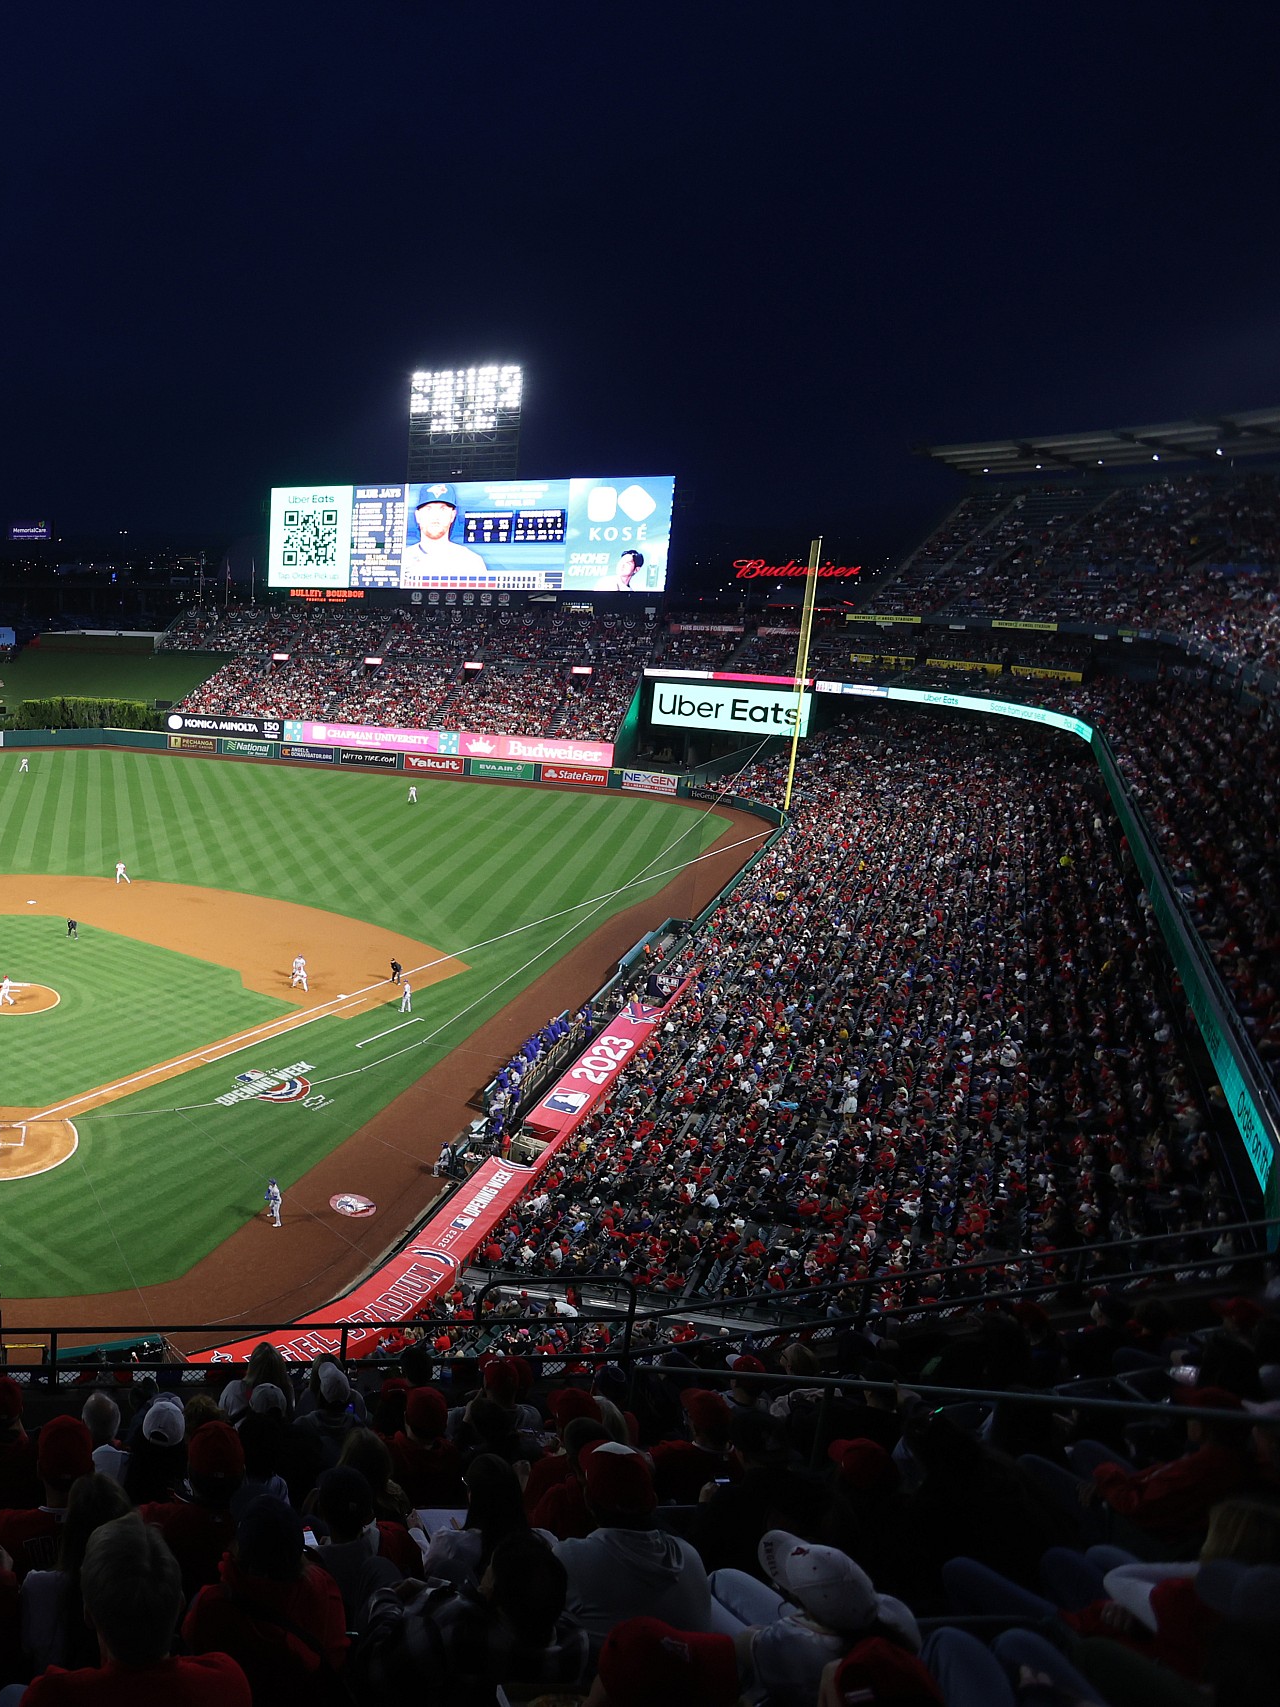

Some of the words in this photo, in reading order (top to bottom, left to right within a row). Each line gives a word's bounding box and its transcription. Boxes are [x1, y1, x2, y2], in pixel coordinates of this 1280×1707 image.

[288, 495, 310, 504] Uber
[312, 494, 335, 504] Eats
[588, 523, 648, 541] KOSÉ
[569, 552, 611, 565] SHOHEI
[568, 565, 609, 577] OHTANI
[732, 558, 862, 578] Budweiser
[326, 590, 365, 599] BOURBON
[923, 693, 942, 704] Uber
[942, 695, 959, 706] Eats
[658, 693, 725, 719] Uber
[730, 698, 803, 726] Eats
[990, 702, 1007, 713] Score
[184, 718, 219, 730] KONICA
[219, 721, 259, 733] MINOLTA
[263, 722, 280, 731] 150
[327, 728, 373, 741] CHAPMAN
[374, 732, 430, 745] UNIVERSITY
[236, 742, 270, 753] National
[291, 750, 333, 760] OCNAVIGATOR.ORG
[508, 740, 603, 762] Budweiser
[342, 752, 363, 761] NITTO
[363, 753, 396, 764] TIRE.COM
[408, 757, 461, 770] Yakult
[624, 772, 676, 787] NEXGEN
[571, 1035, 635, 1085] 2023
[214, 1077, 280, 1107] OPENING
[273, 1060, 317, 1081] WEEK
[461, 1183, 498, 1219] OPENING
[489, 1168, 515, 1193] WEEK
[438, 1229, 458, 1249] 2023
[335, 1262, 445, 1340] STADIUM
